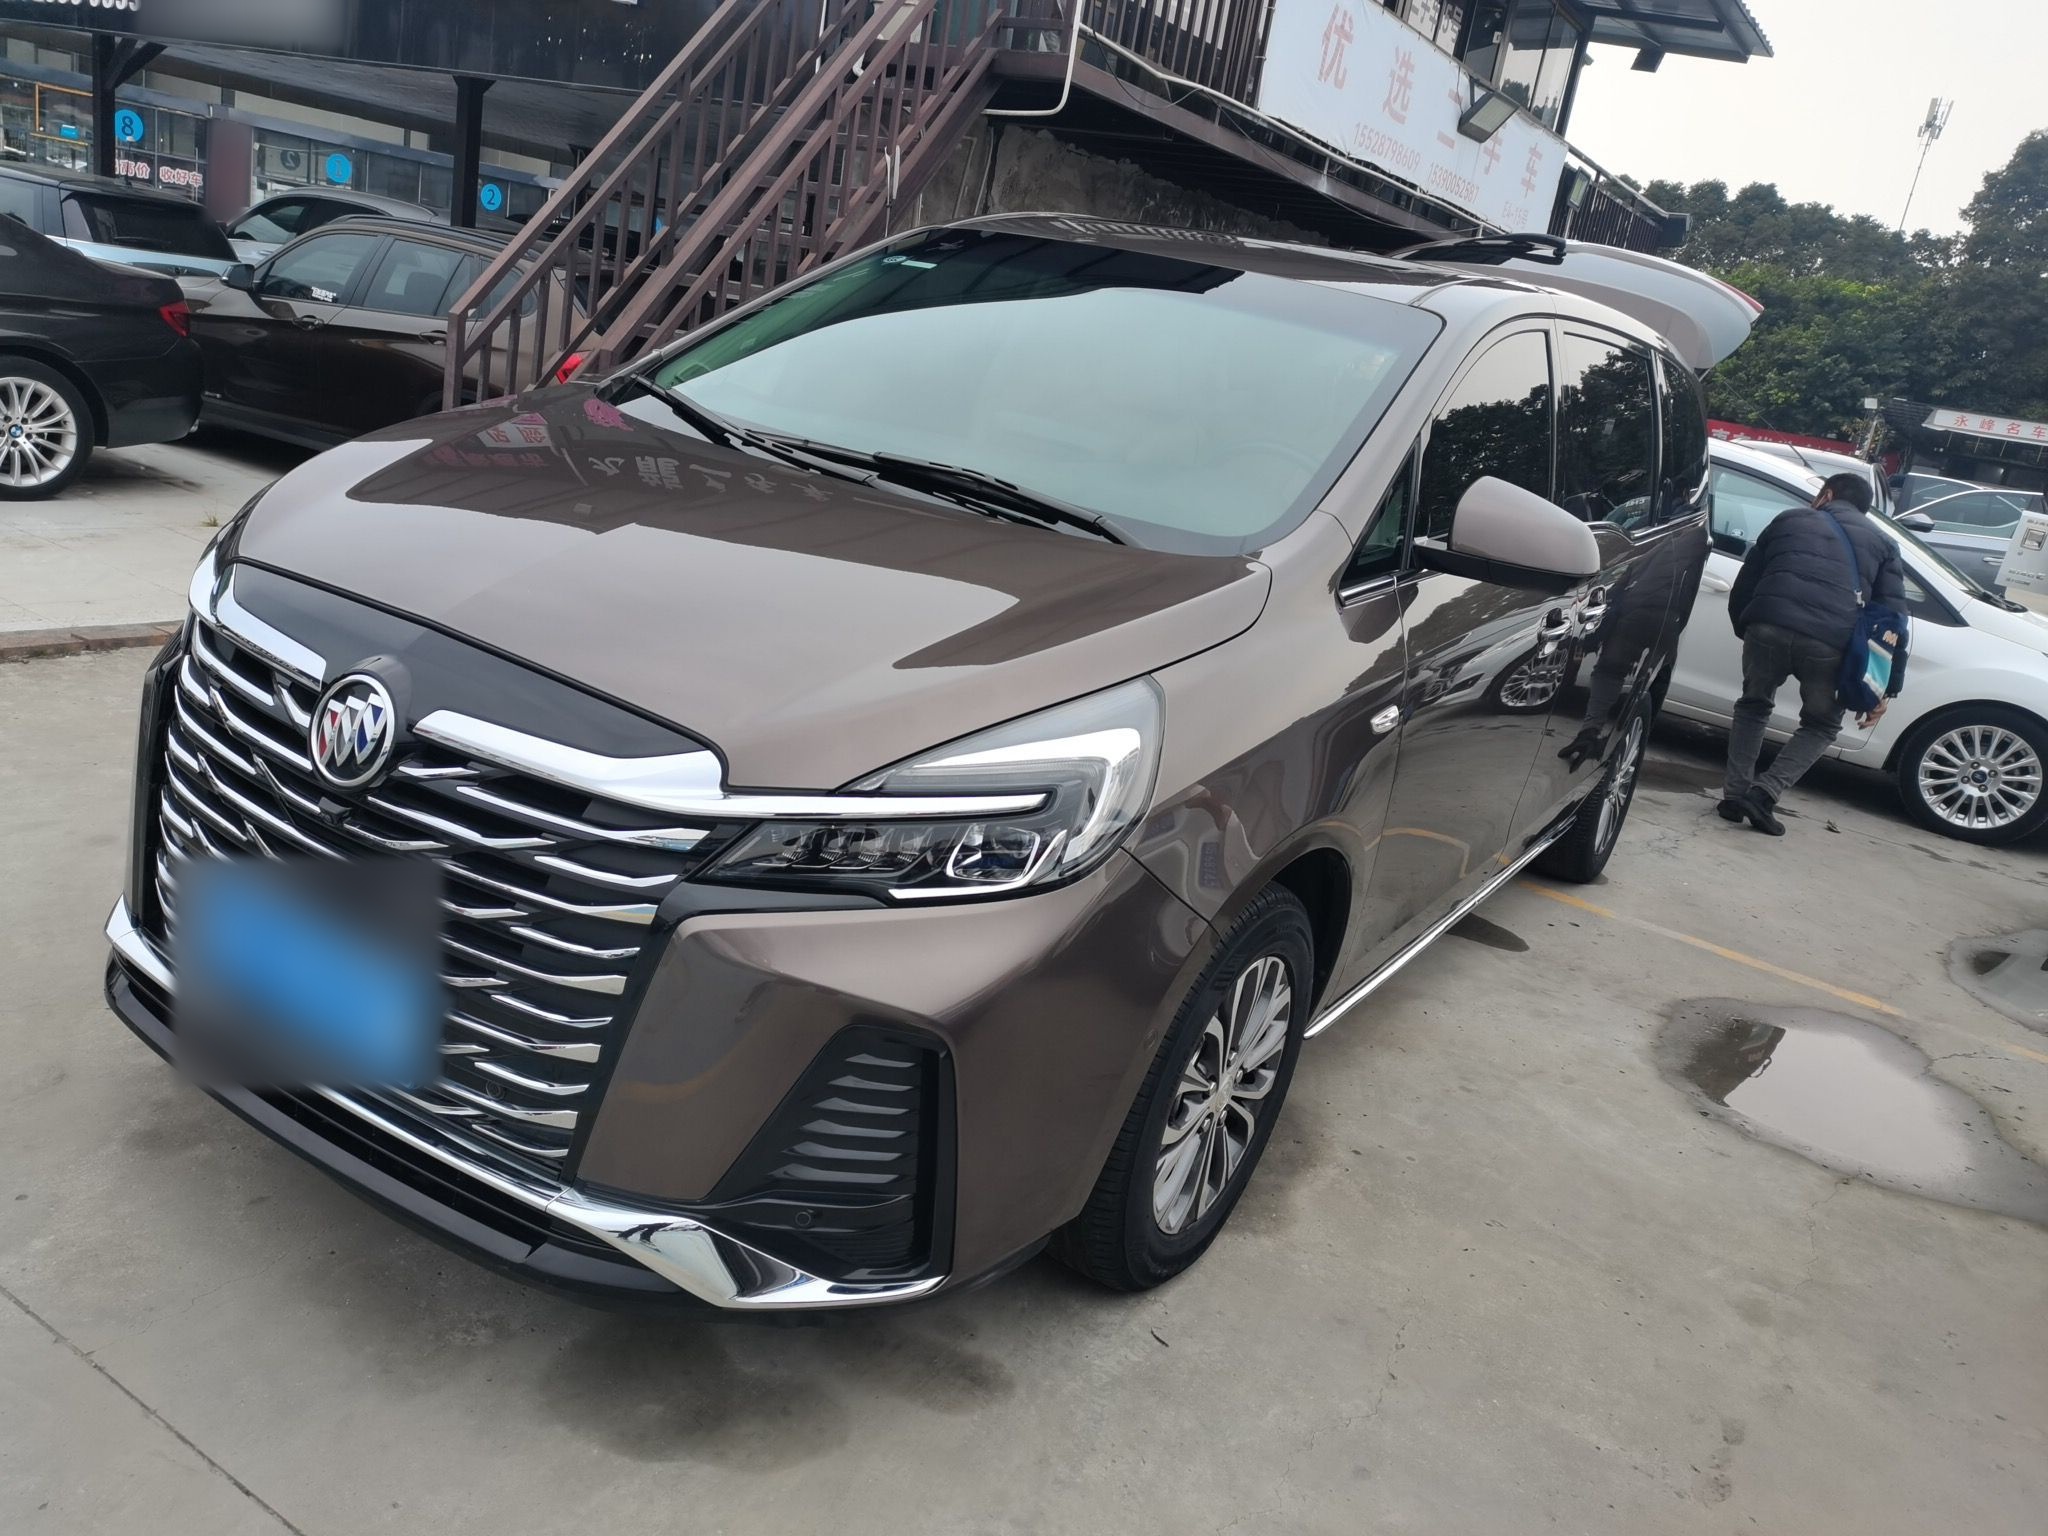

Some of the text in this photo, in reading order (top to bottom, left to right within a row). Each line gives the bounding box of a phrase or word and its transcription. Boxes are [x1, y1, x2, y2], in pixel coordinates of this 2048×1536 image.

[121, 116, 134, 136] 8
[160, 166, 203, 187] 收好车
